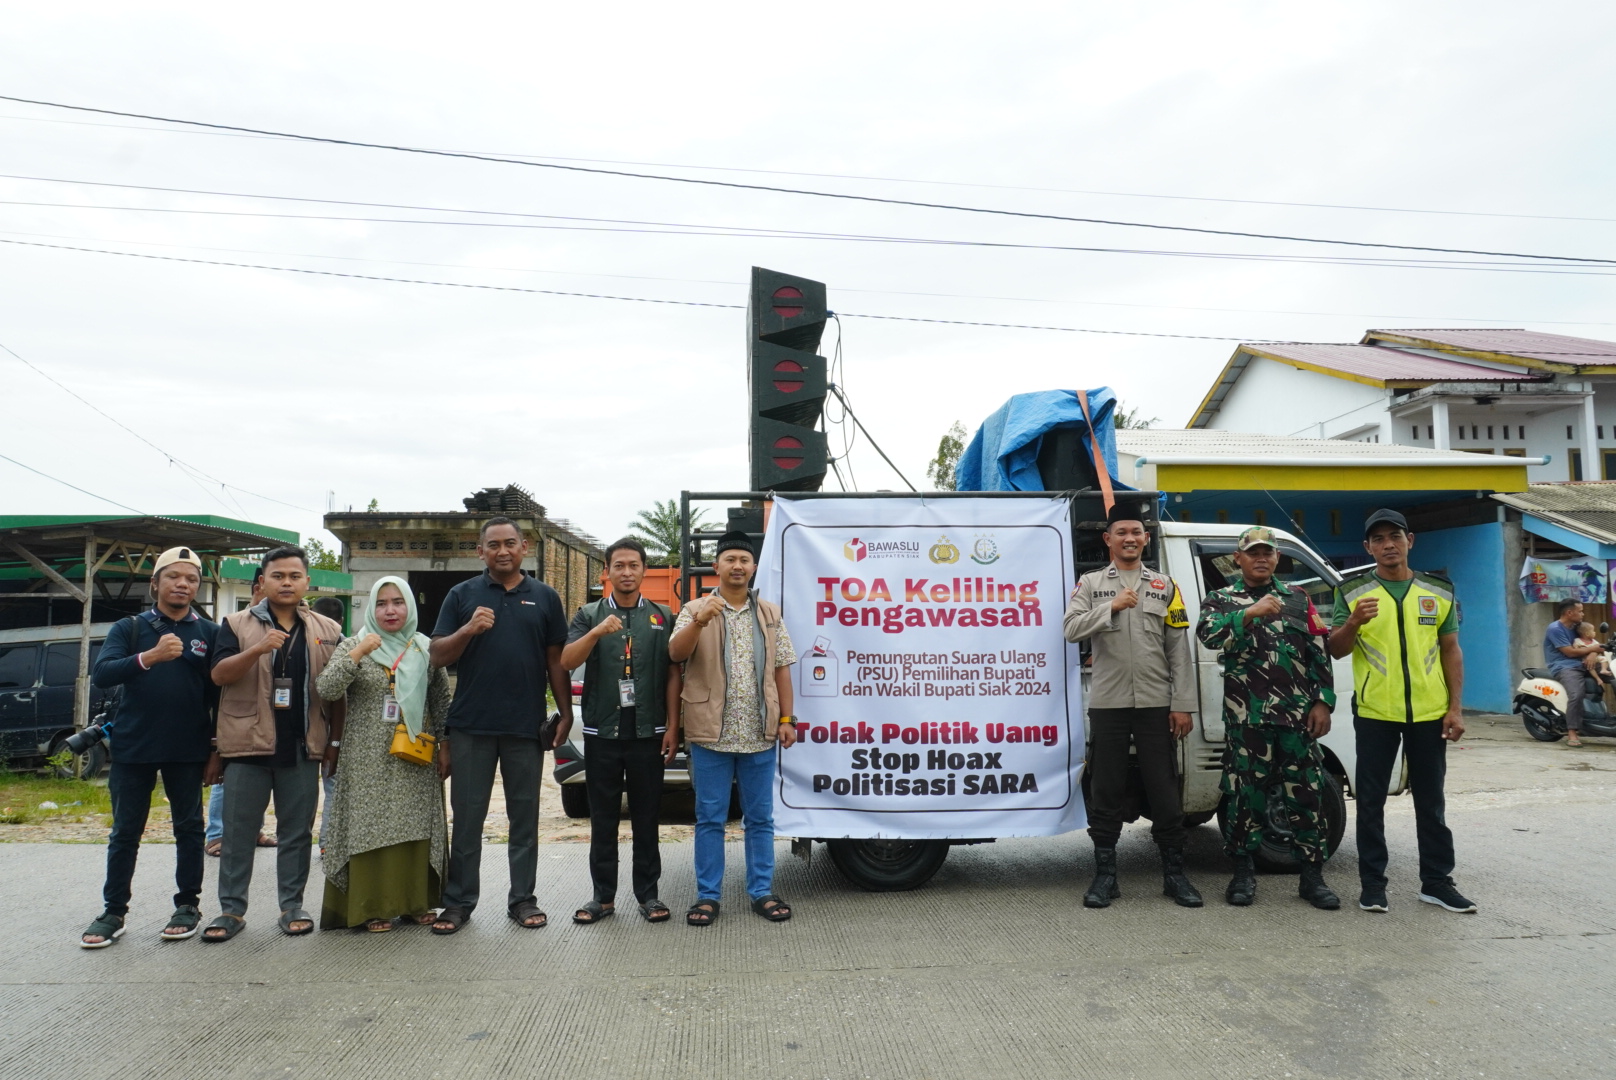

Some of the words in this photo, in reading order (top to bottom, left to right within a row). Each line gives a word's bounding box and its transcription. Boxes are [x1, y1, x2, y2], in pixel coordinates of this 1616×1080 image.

[868, 541, 920, 552] BAWASLU
[817, 577, 893, 602] TOA
[904, 577, 1040, 610] Keliling
[1093, 590, 1116, 599] SENO
[1145, 591, 1168, 602] POLRI
[816, 601, 1043, 634] Pengawasan
[847, 650, 948, 668] Pemungutan
[951, 650, 997, 665] Suara
[1000, 649, 1046, 667] Ulang
[857, 666, 899, 683] (PSU)
[902, 666, 980, 681] Pemilihan
[983, 665, 1036, 684] Bupati
[842, 681, 873, 696] dan
[875, 682, 921, 697] Wakil
[924, 682, 975, 701] Bupati
[978, 682, 1012, 696] Siak
[1014, 681, 1051, 696] 2024
[795, 721, 875, 745] Tolak
[881, 721, 980, 745] Politik
[985, 722, 1059, 747] Uang
[851, 747, 920, 774] Stop
[927, 749, 1003, 770] Hoax
[813, 772, 956, 796] Politisasi
[962, 773, 1039, 795] SARA
